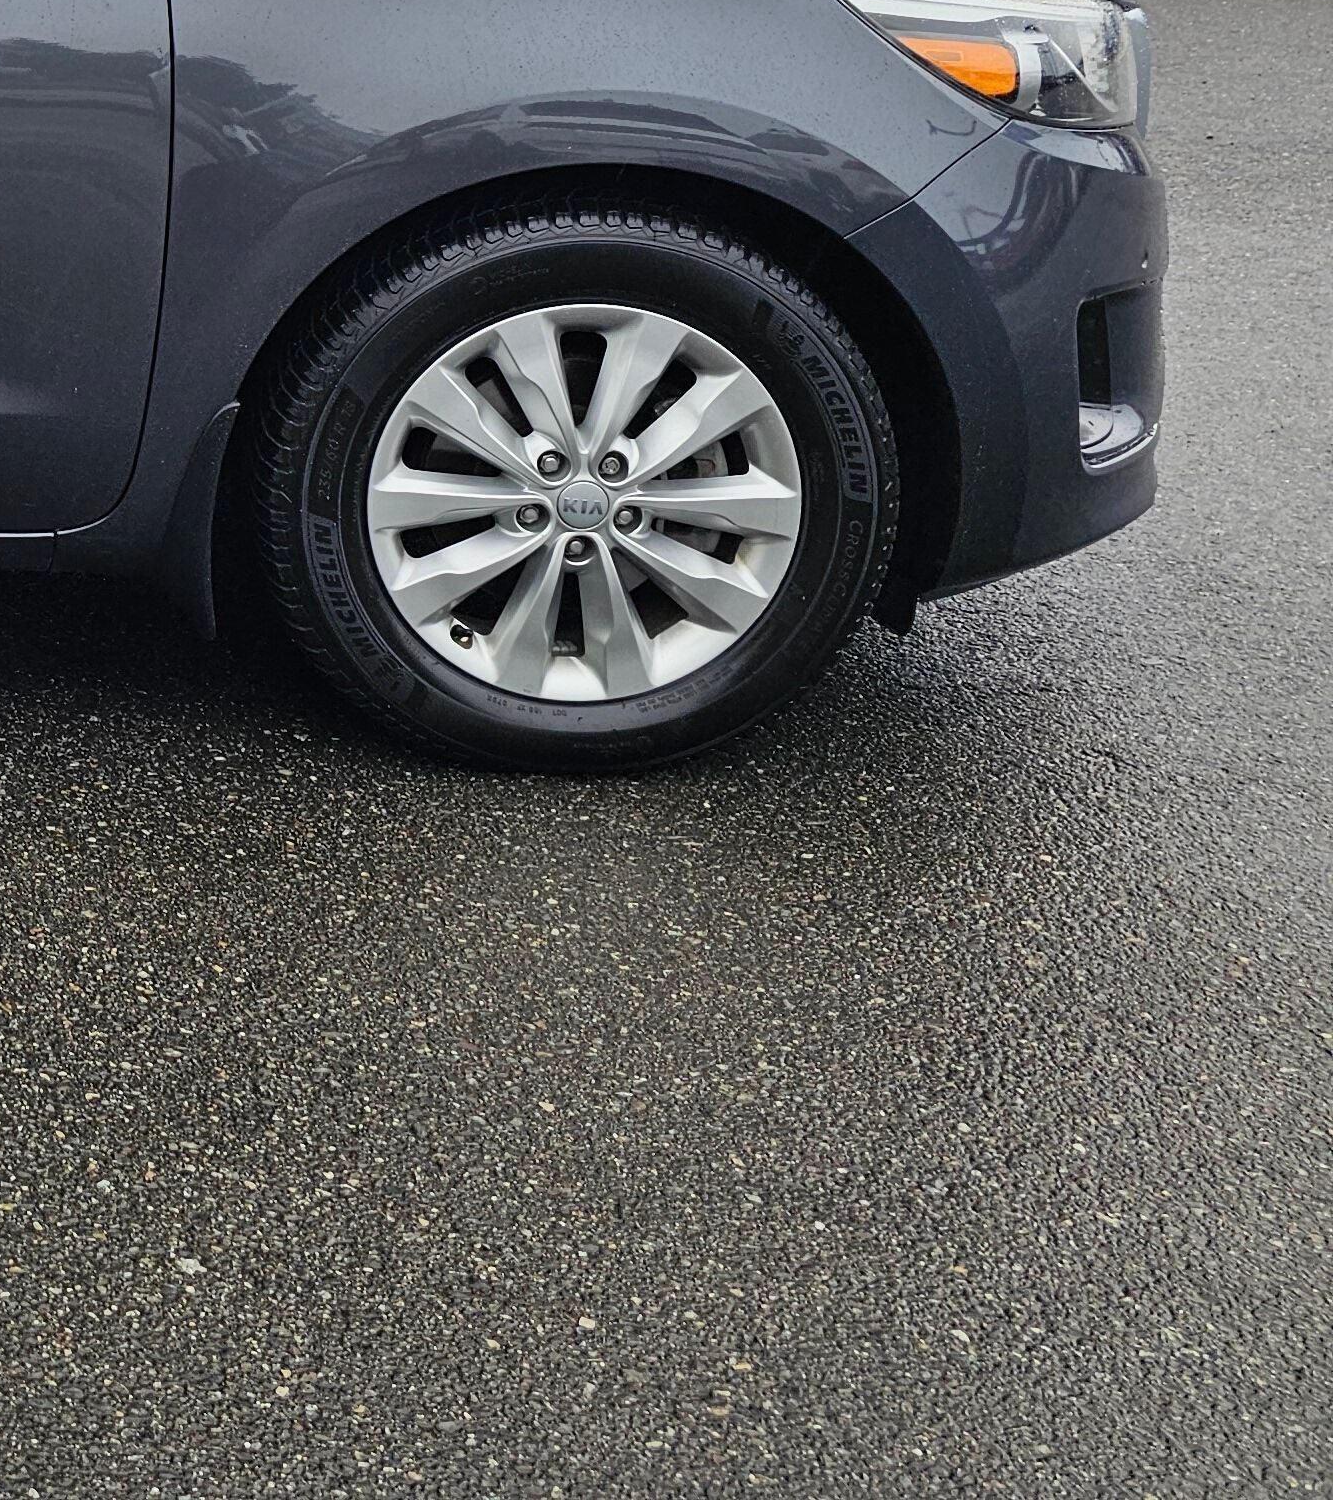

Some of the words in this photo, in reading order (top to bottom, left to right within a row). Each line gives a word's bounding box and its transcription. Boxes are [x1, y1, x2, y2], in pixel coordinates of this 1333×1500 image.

[801, 354, 868, 493] MICHELIN
[563, 497, 603, 515] KIA
[313, 522, 380, 659] MICHELIN
